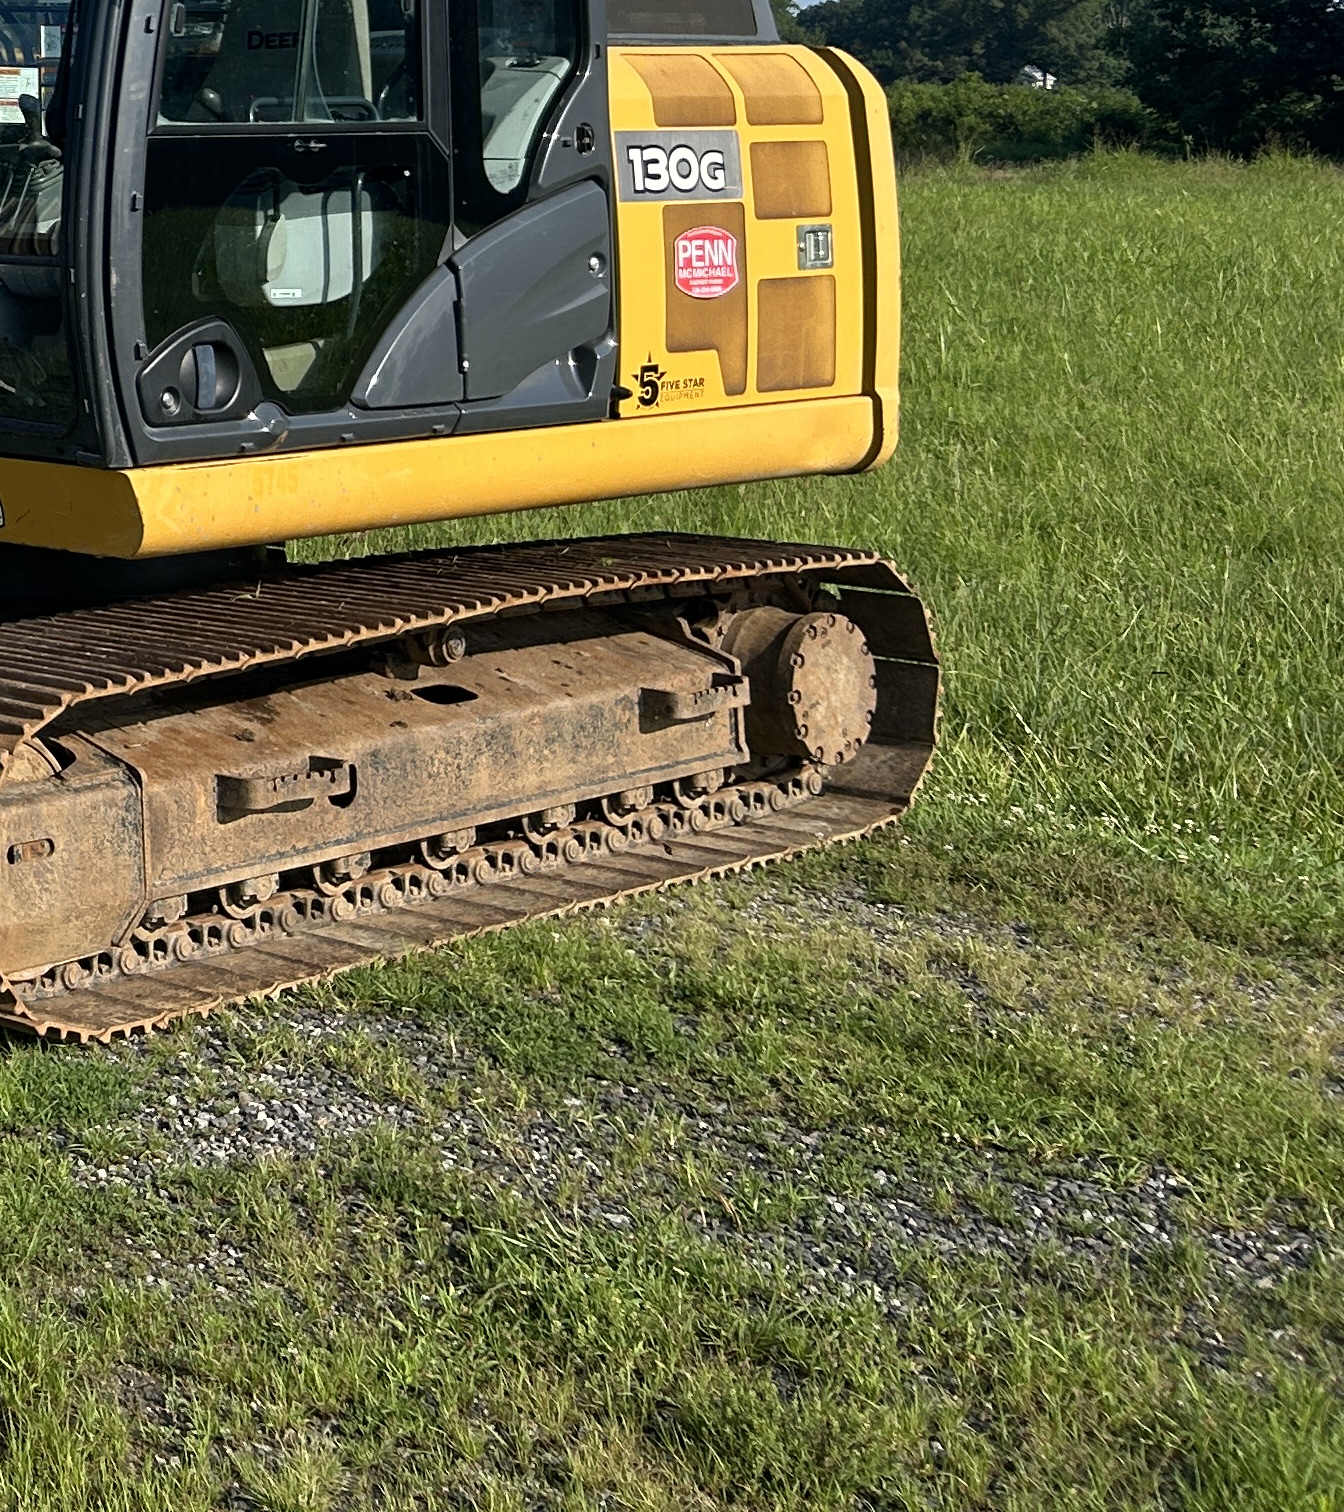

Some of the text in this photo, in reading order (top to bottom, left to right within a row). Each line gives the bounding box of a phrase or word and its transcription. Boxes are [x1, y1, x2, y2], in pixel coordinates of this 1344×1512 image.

[627, 145, 726, 193] 130G
[678, 239, 733, 267] PENN
[637, 364, 660, 407] 5
[660, 377, 705, 391] FIVE STAR
